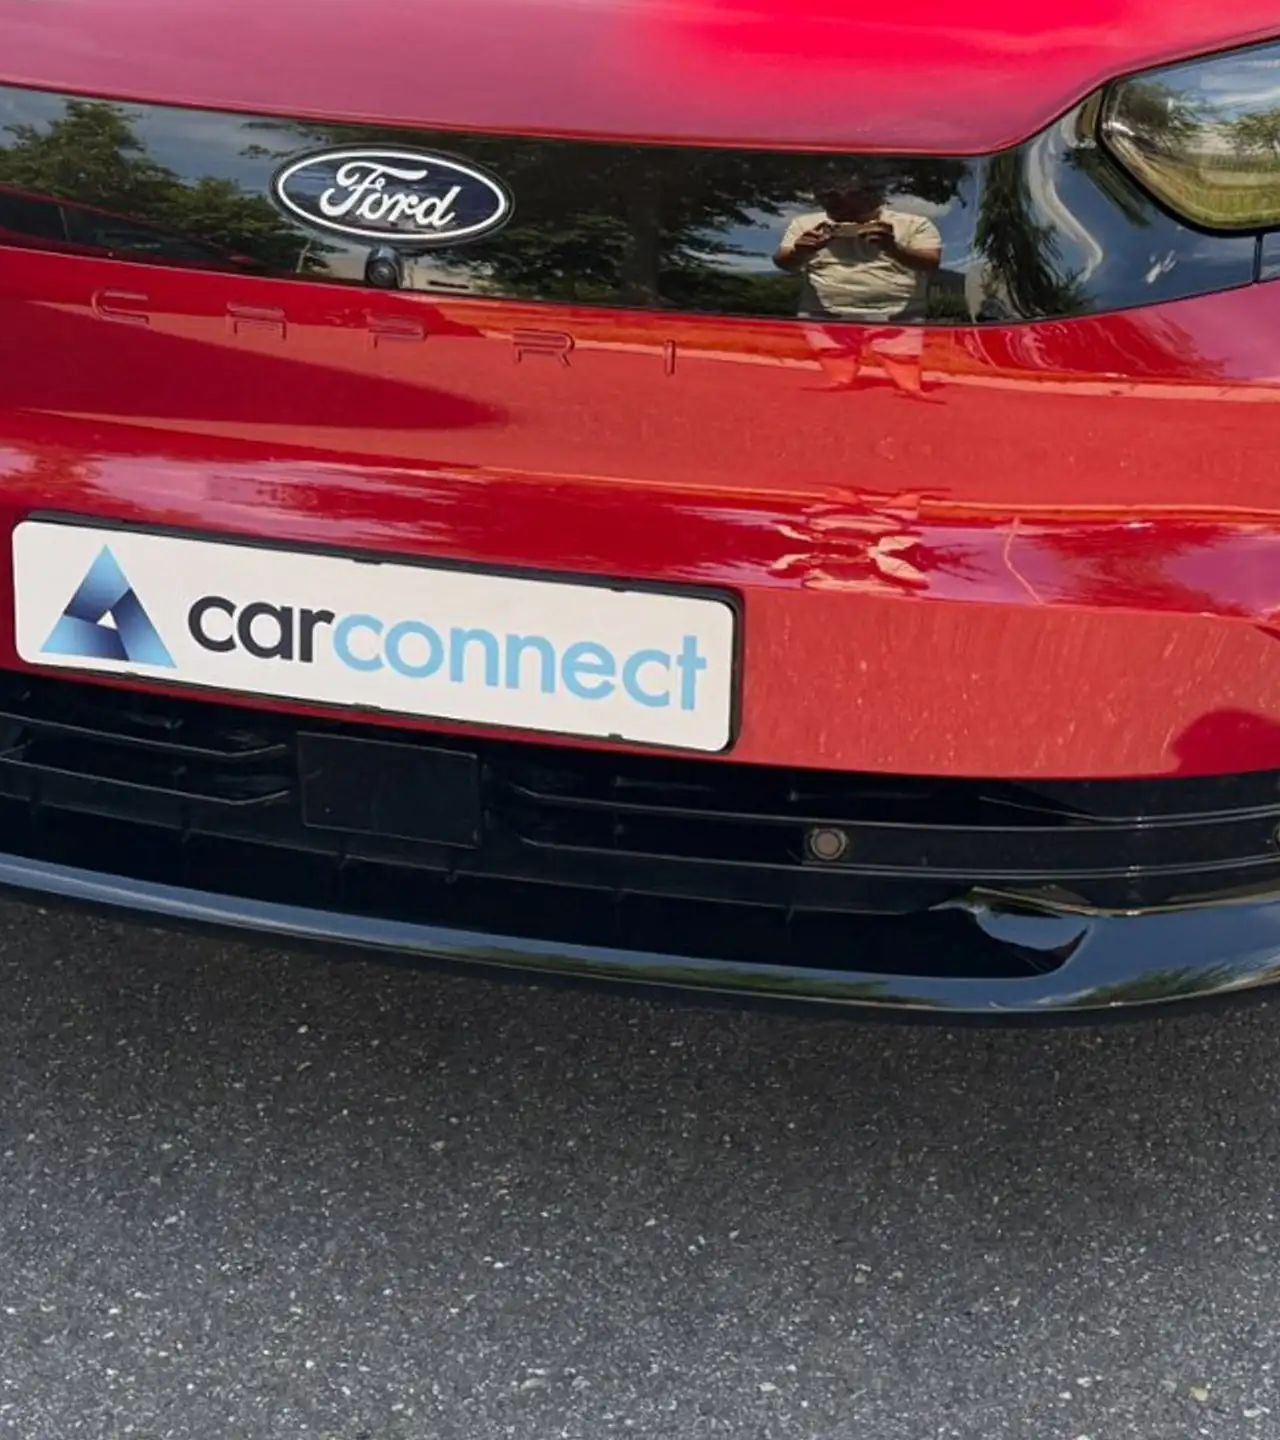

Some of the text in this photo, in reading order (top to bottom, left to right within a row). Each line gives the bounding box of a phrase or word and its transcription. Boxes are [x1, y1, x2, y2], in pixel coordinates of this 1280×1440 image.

[320, 162, 462, 227] Ford
[90, 289, 677, 376] CAPRI
[187, 594, 707, 711] carconnect
